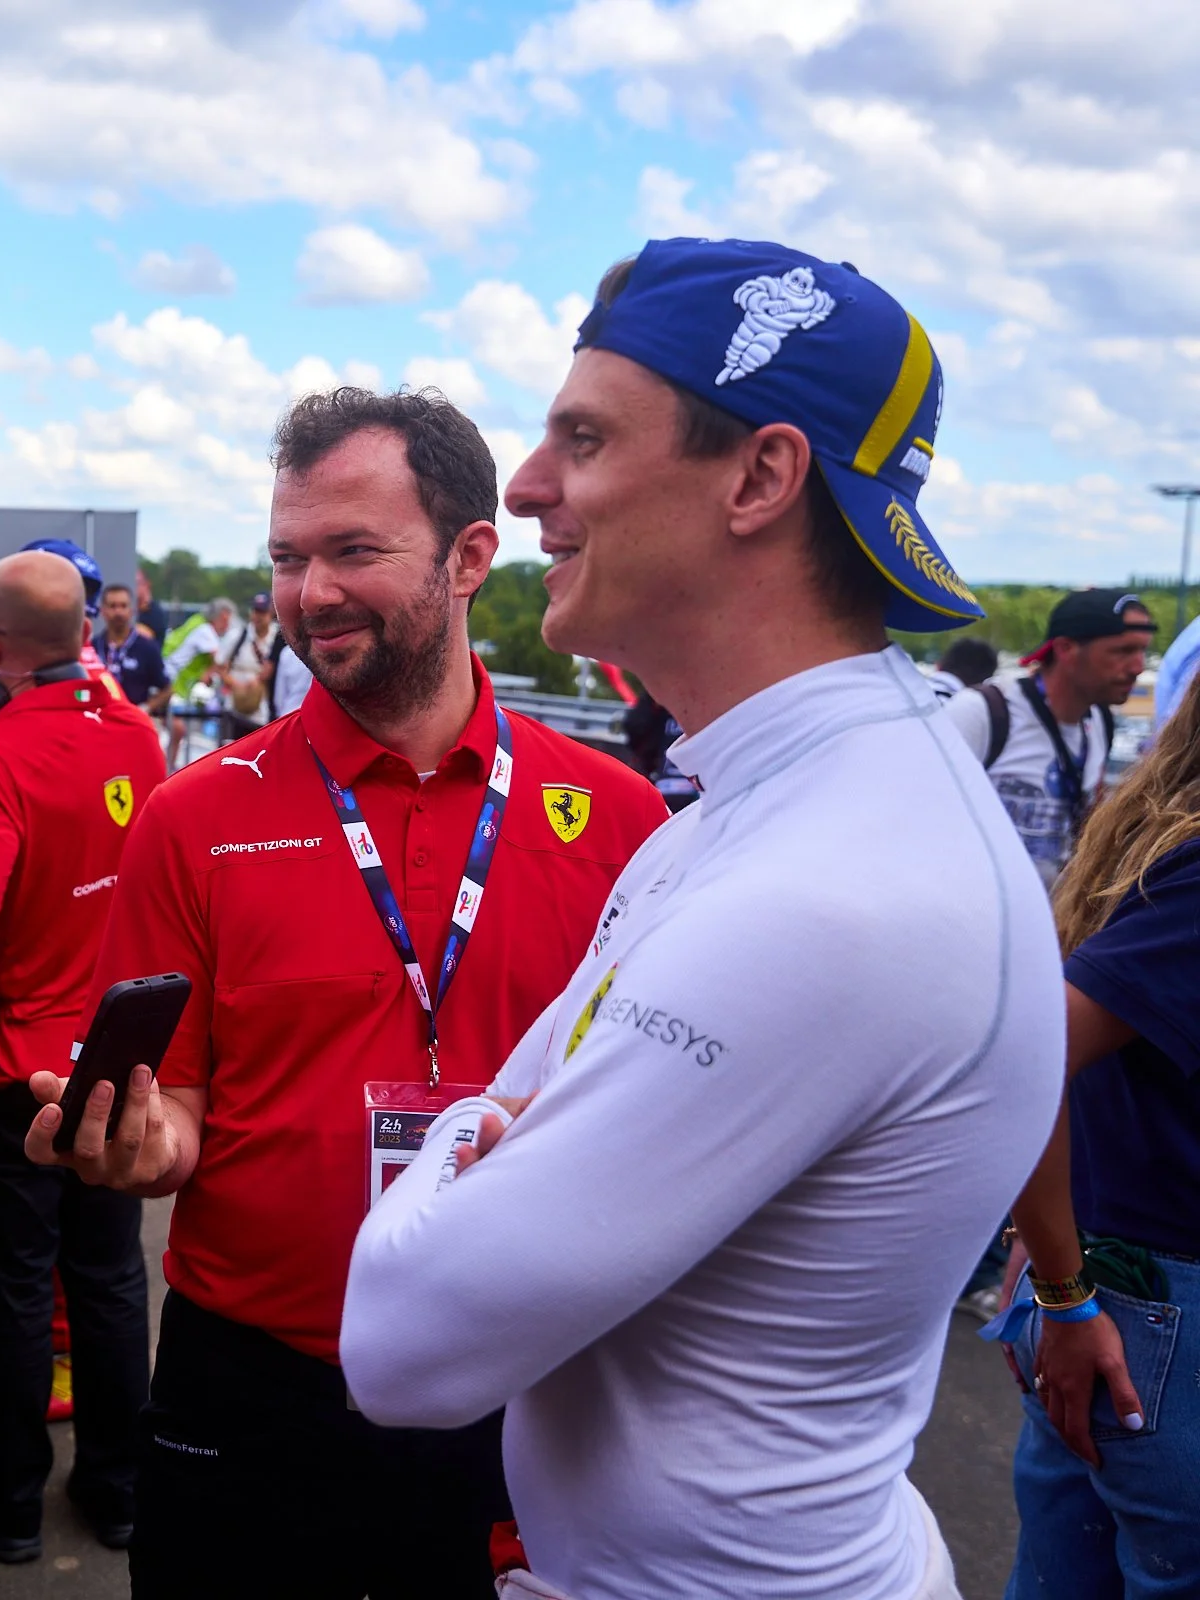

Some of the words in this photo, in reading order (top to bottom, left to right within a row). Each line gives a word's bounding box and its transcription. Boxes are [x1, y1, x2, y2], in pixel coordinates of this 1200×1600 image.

[210, 839, 302, 856] COMPETIZIONI
[303, 837, 323, 848] GT
[388, 916, 398, 928] 100
[602, 998, 723, 1067] GENESYS
[380, 1117, 402, 1131] 24h
[379, 1134, 401, 1144] 2023
